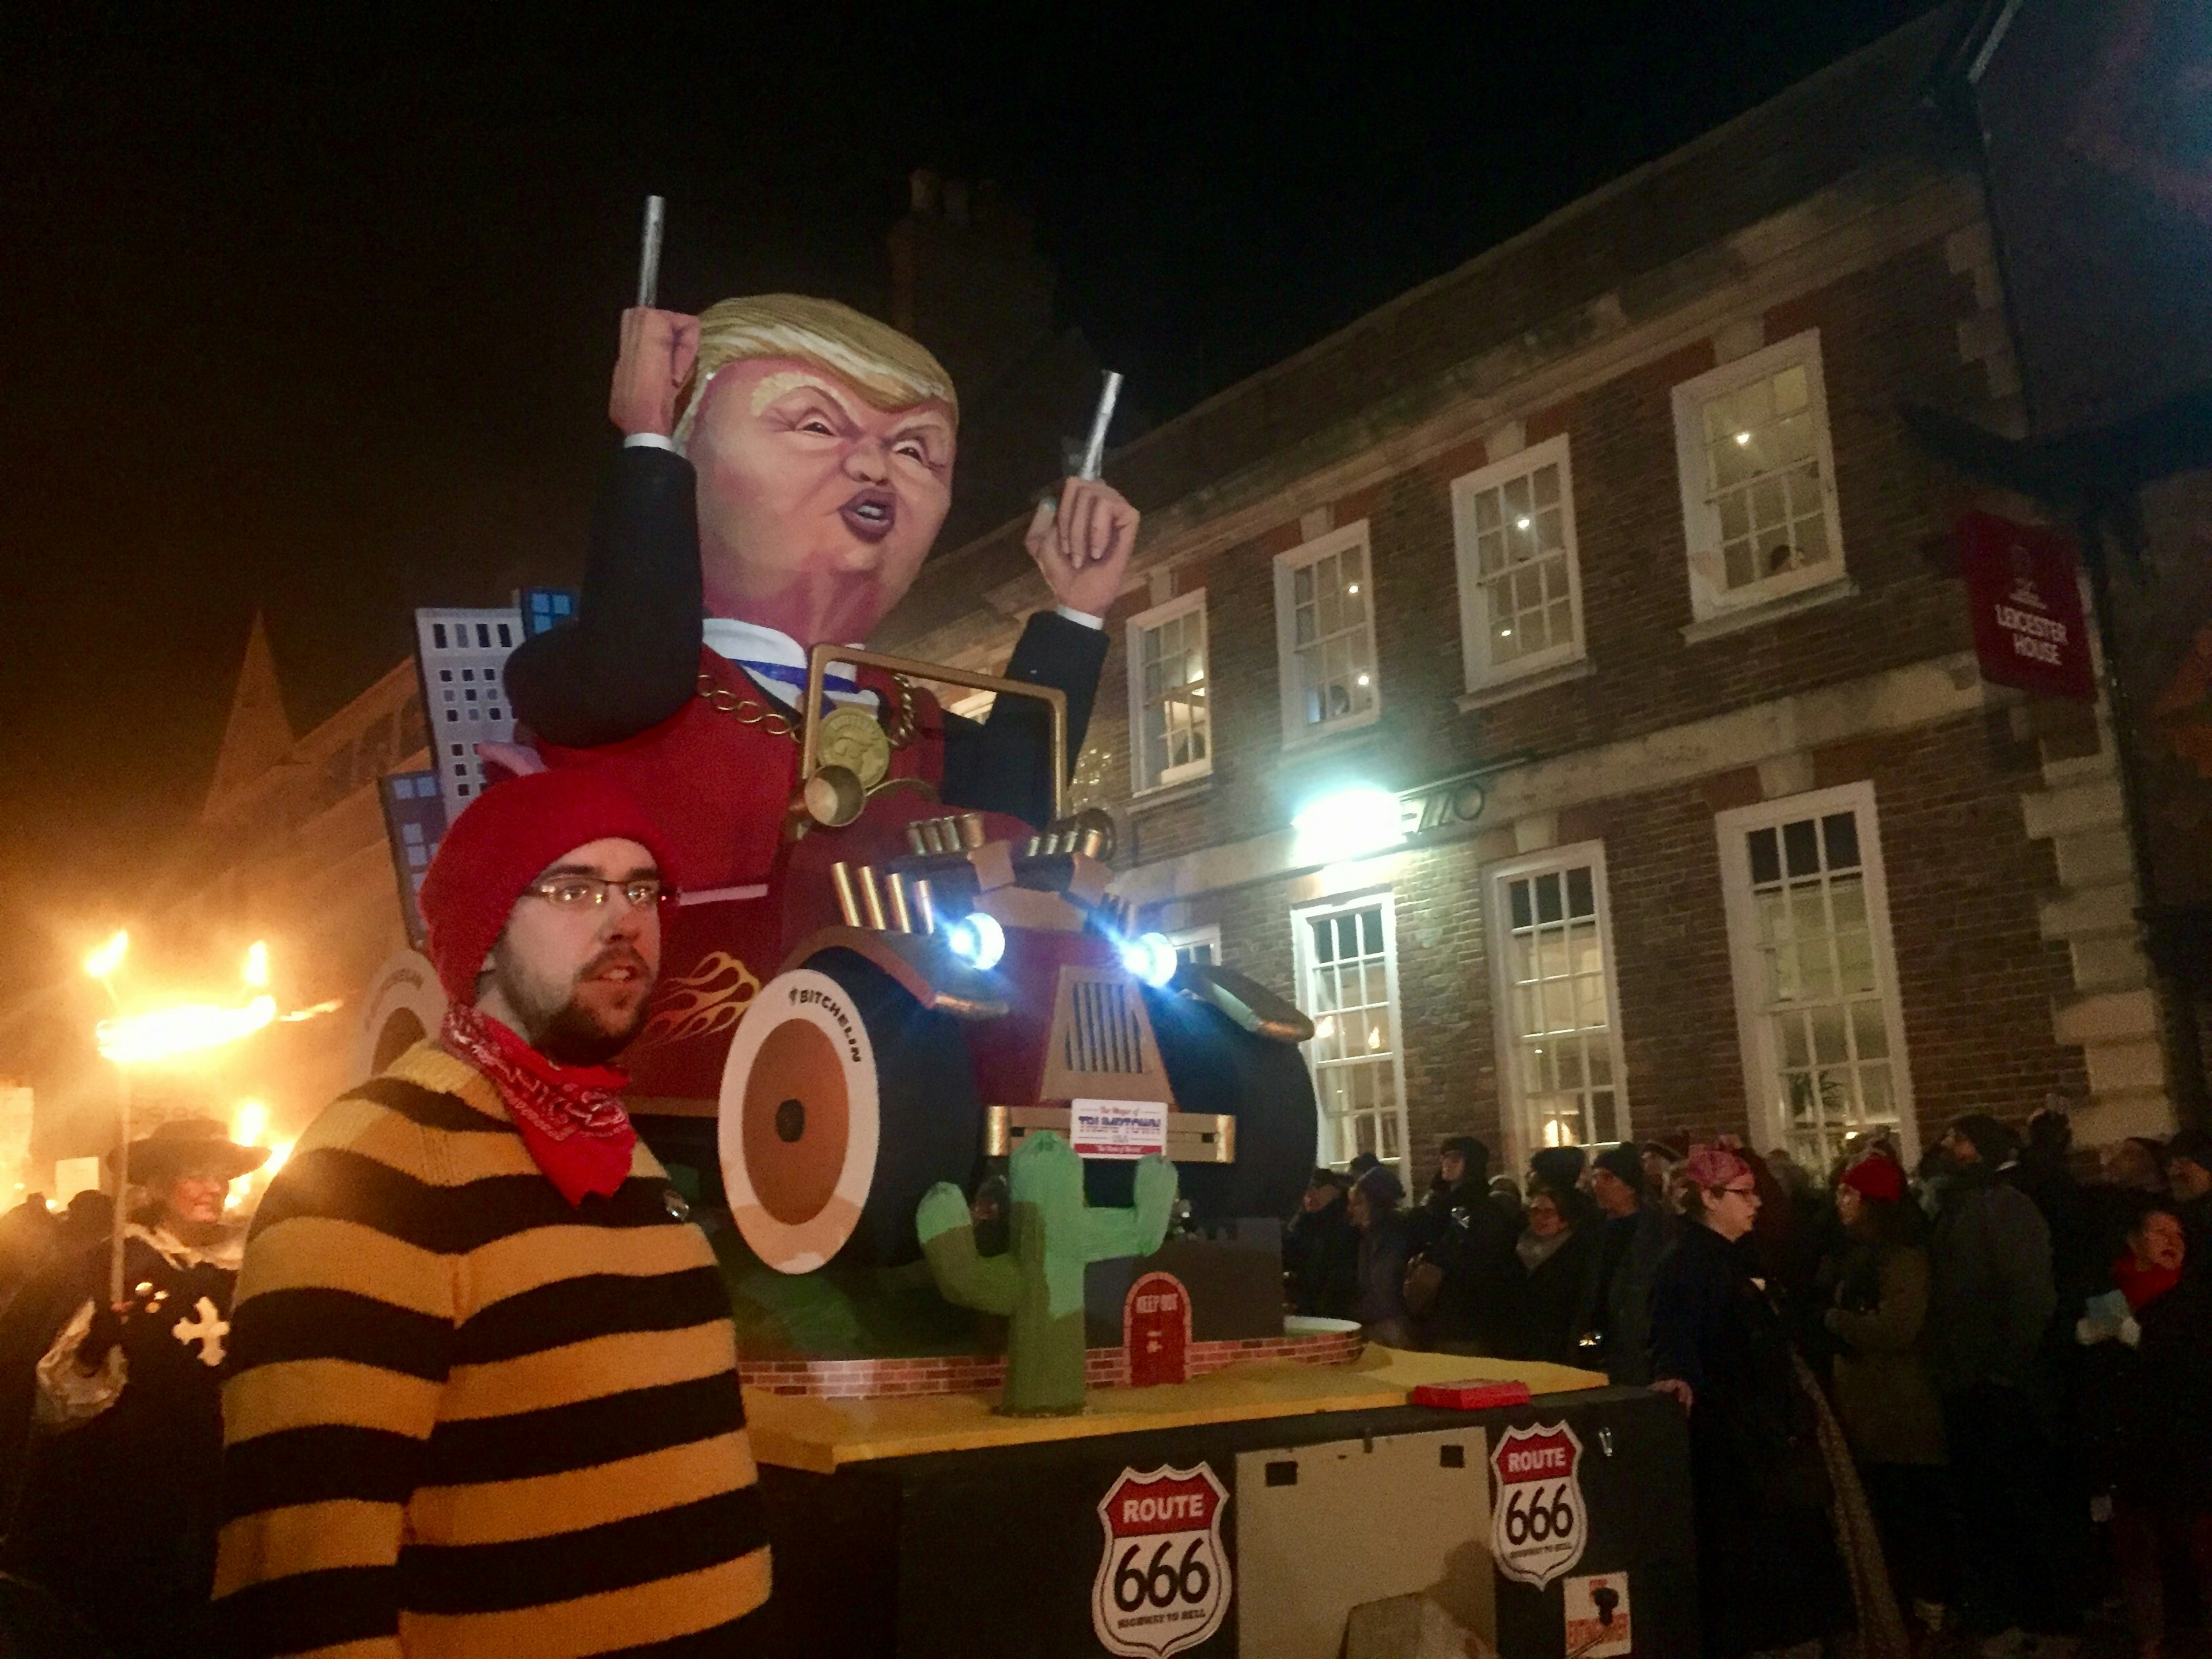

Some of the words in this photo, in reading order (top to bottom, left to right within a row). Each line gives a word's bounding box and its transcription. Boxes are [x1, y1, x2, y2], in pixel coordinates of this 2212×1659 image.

[1994, 604, 2069, 645] LEICESTER
[2013, 632, 2062, 666] HOUSE
[1508, 1446, 1566, 1473] ROUTE
[1123, 1493, 1205, 1524] ROUTE
[1505, 1483, 1574, 1546] 666
[1113, 1537, 1211, 1612] 666
